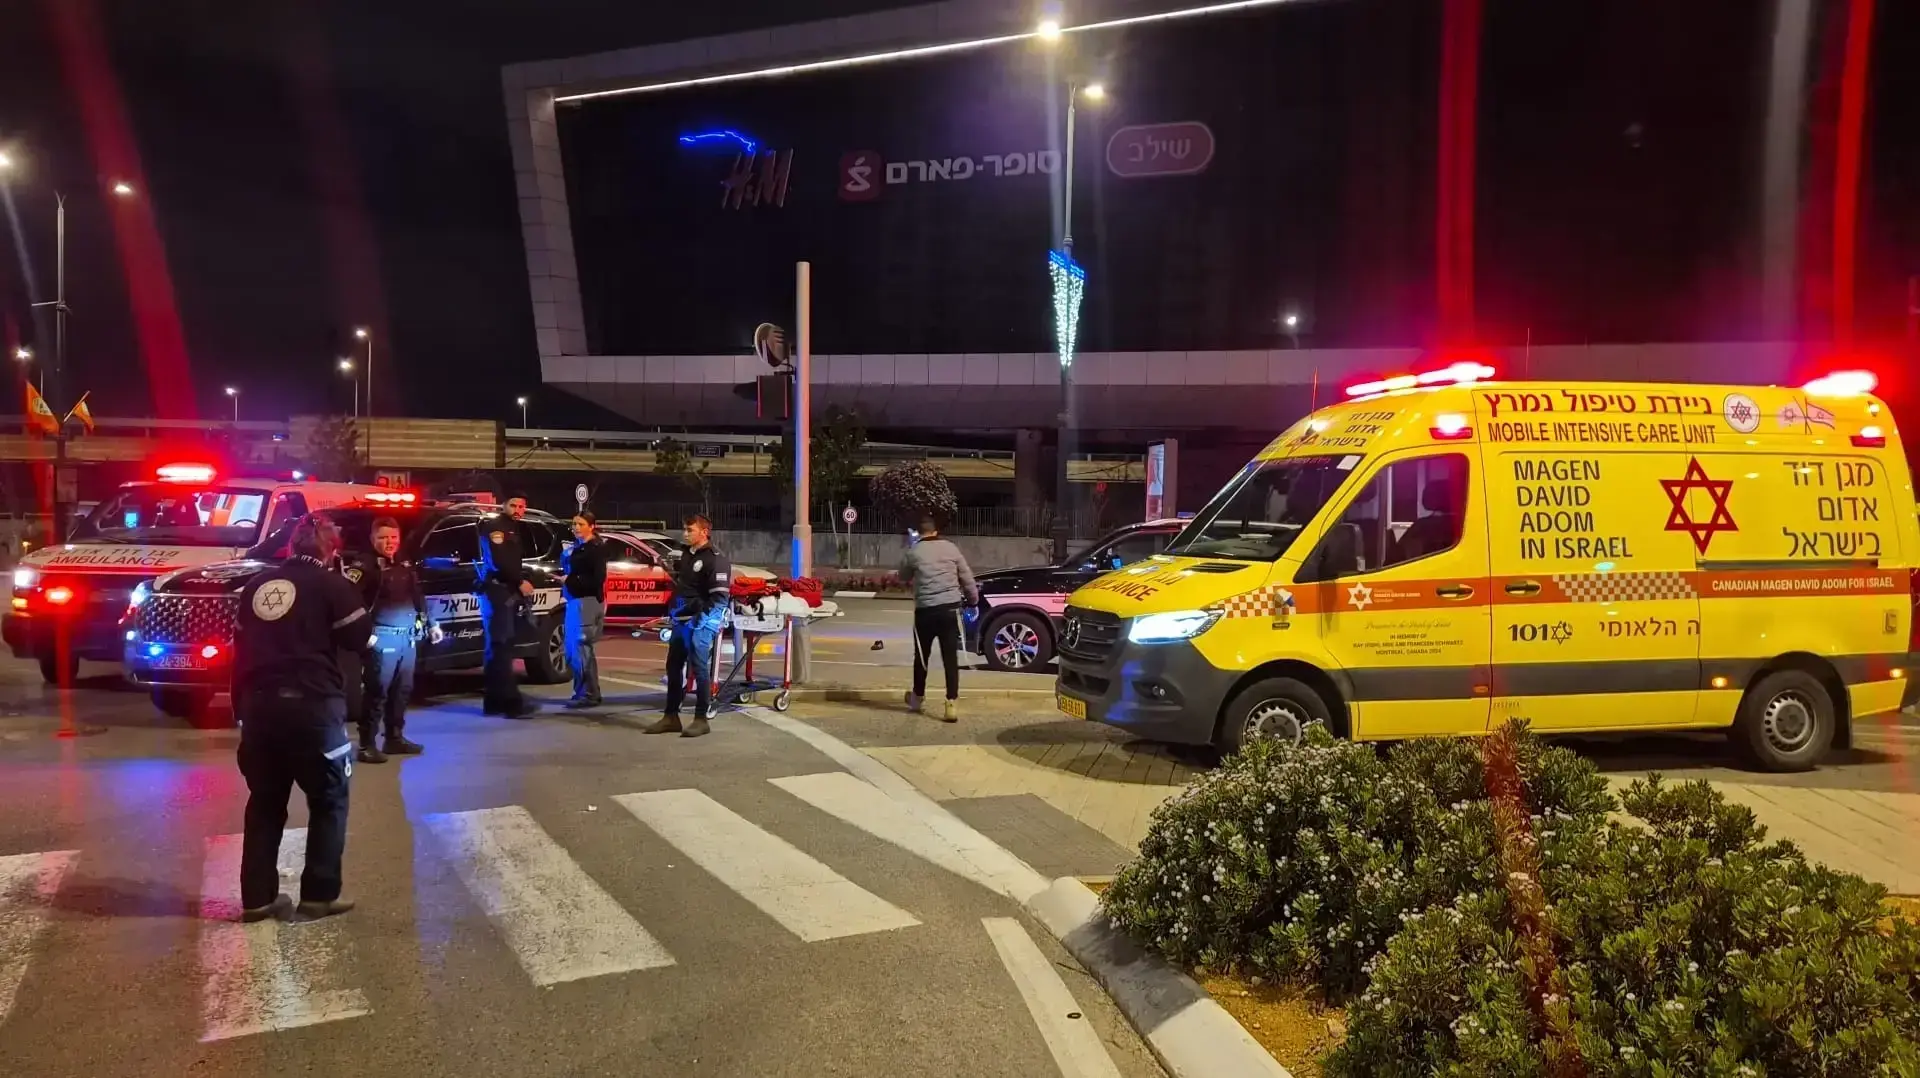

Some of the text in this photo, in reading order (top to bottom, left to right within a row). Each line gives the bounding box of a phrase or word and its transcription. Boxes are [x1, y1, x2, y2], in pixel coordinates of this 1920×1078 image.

[1128, 135, 1191, 162] שילב
[885, 150, 1063, 184] סופר-פארם
[1483, 388, 1713, 418] ניידת טיפול נמרץ
[1488, 421, 1716, 444] MOBILE INTENSIVE CARE UNIT
[1513, 459, 1601, 481] MAGEN
[1783, 461, 1874, 492] מגן דוד
[1516, 485, 1591, 507] DAVID
[1817, 496, 1879, 521] אדום
[1520, 511, 1594, 533] ADOM
[1520, 537, 1633, 559] IN ISRAEL
[1782, 526, 1882, 557] בישראל
[47, 556, 168, 566] AMBULANCE
[1712, 576, 1894, 591] CANADIAN MAGEN DAVID ADOM FOR ISRAEL
[440, 597, 480, 613] שראל
[1508, 623, 1548, 642] 101
[1599, 616, 1677, 638] הלאומי
